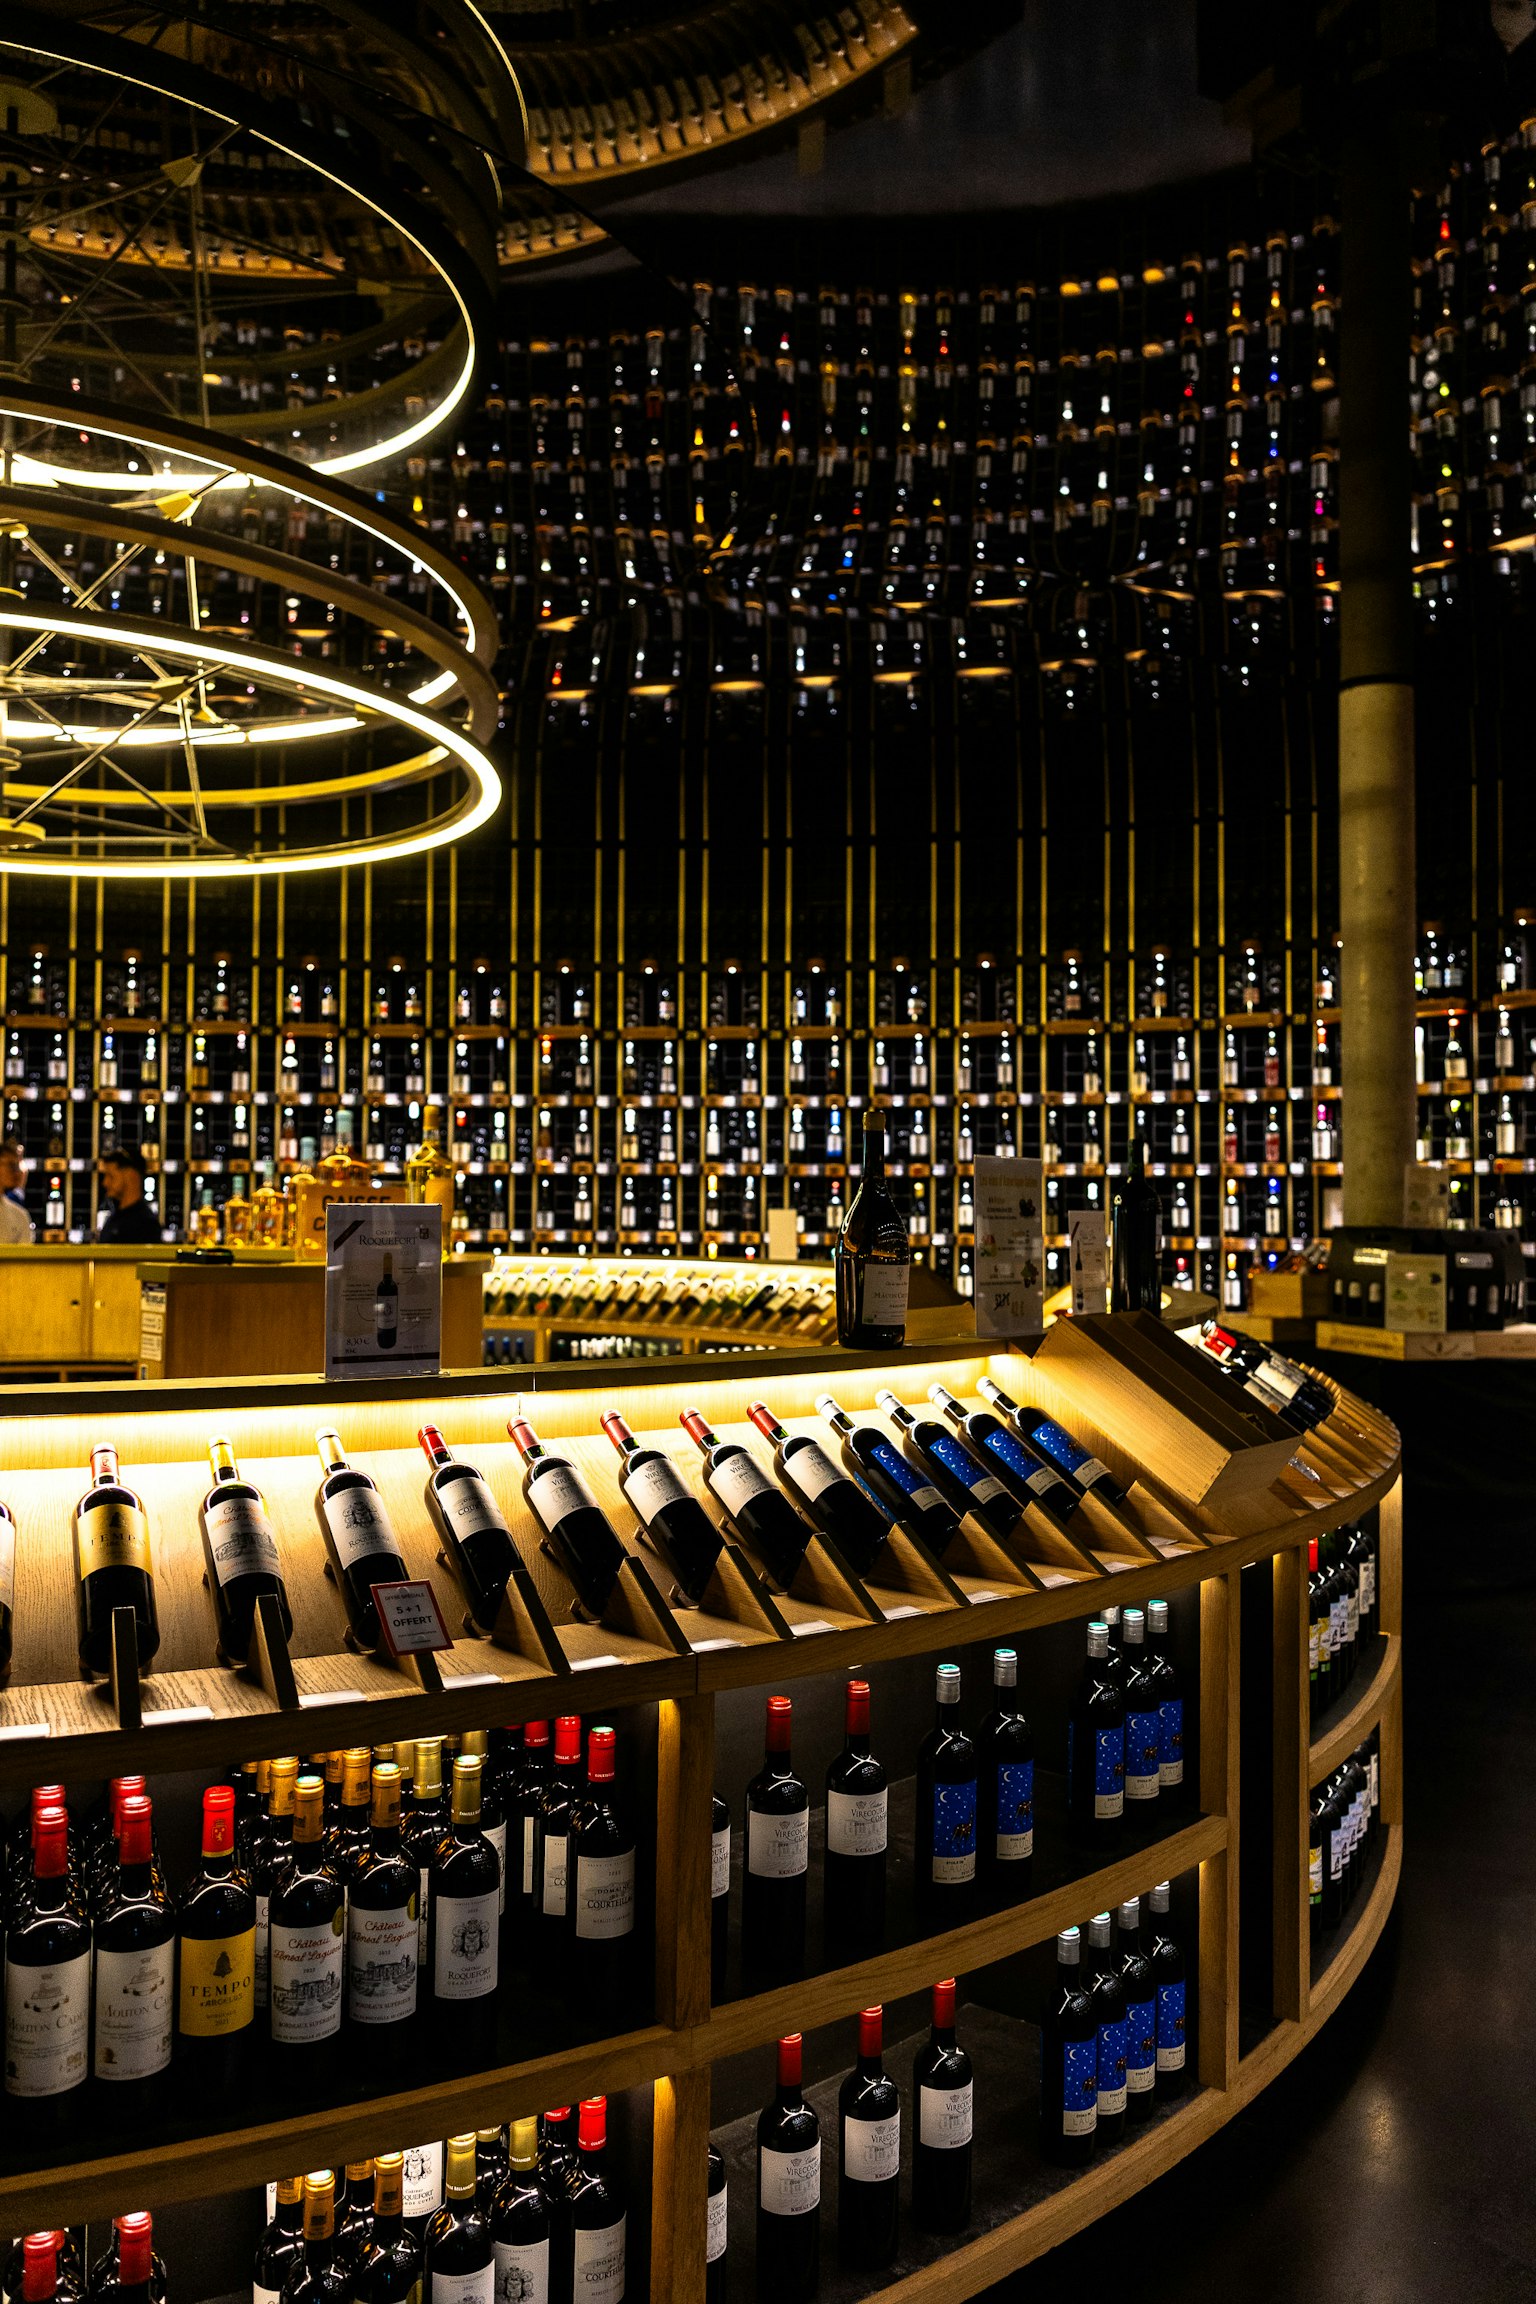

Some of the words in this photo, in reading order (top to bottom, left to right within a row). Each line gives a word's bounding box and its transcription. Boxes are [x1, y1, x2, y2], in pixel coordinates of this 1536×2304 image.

[359, 1234, 418, 1246] ROQUEFORT
[396, 1606, 404, 1614] 5
[416, 1604, 421, 1612] 1
[392, 1615, 432, 1627] OFFERT
[288, 1937, 330, 1949] Château
[448, 1967, 491, 1980] ROQUEFORT
[190, 1976, 251, 1998] TEMPO
